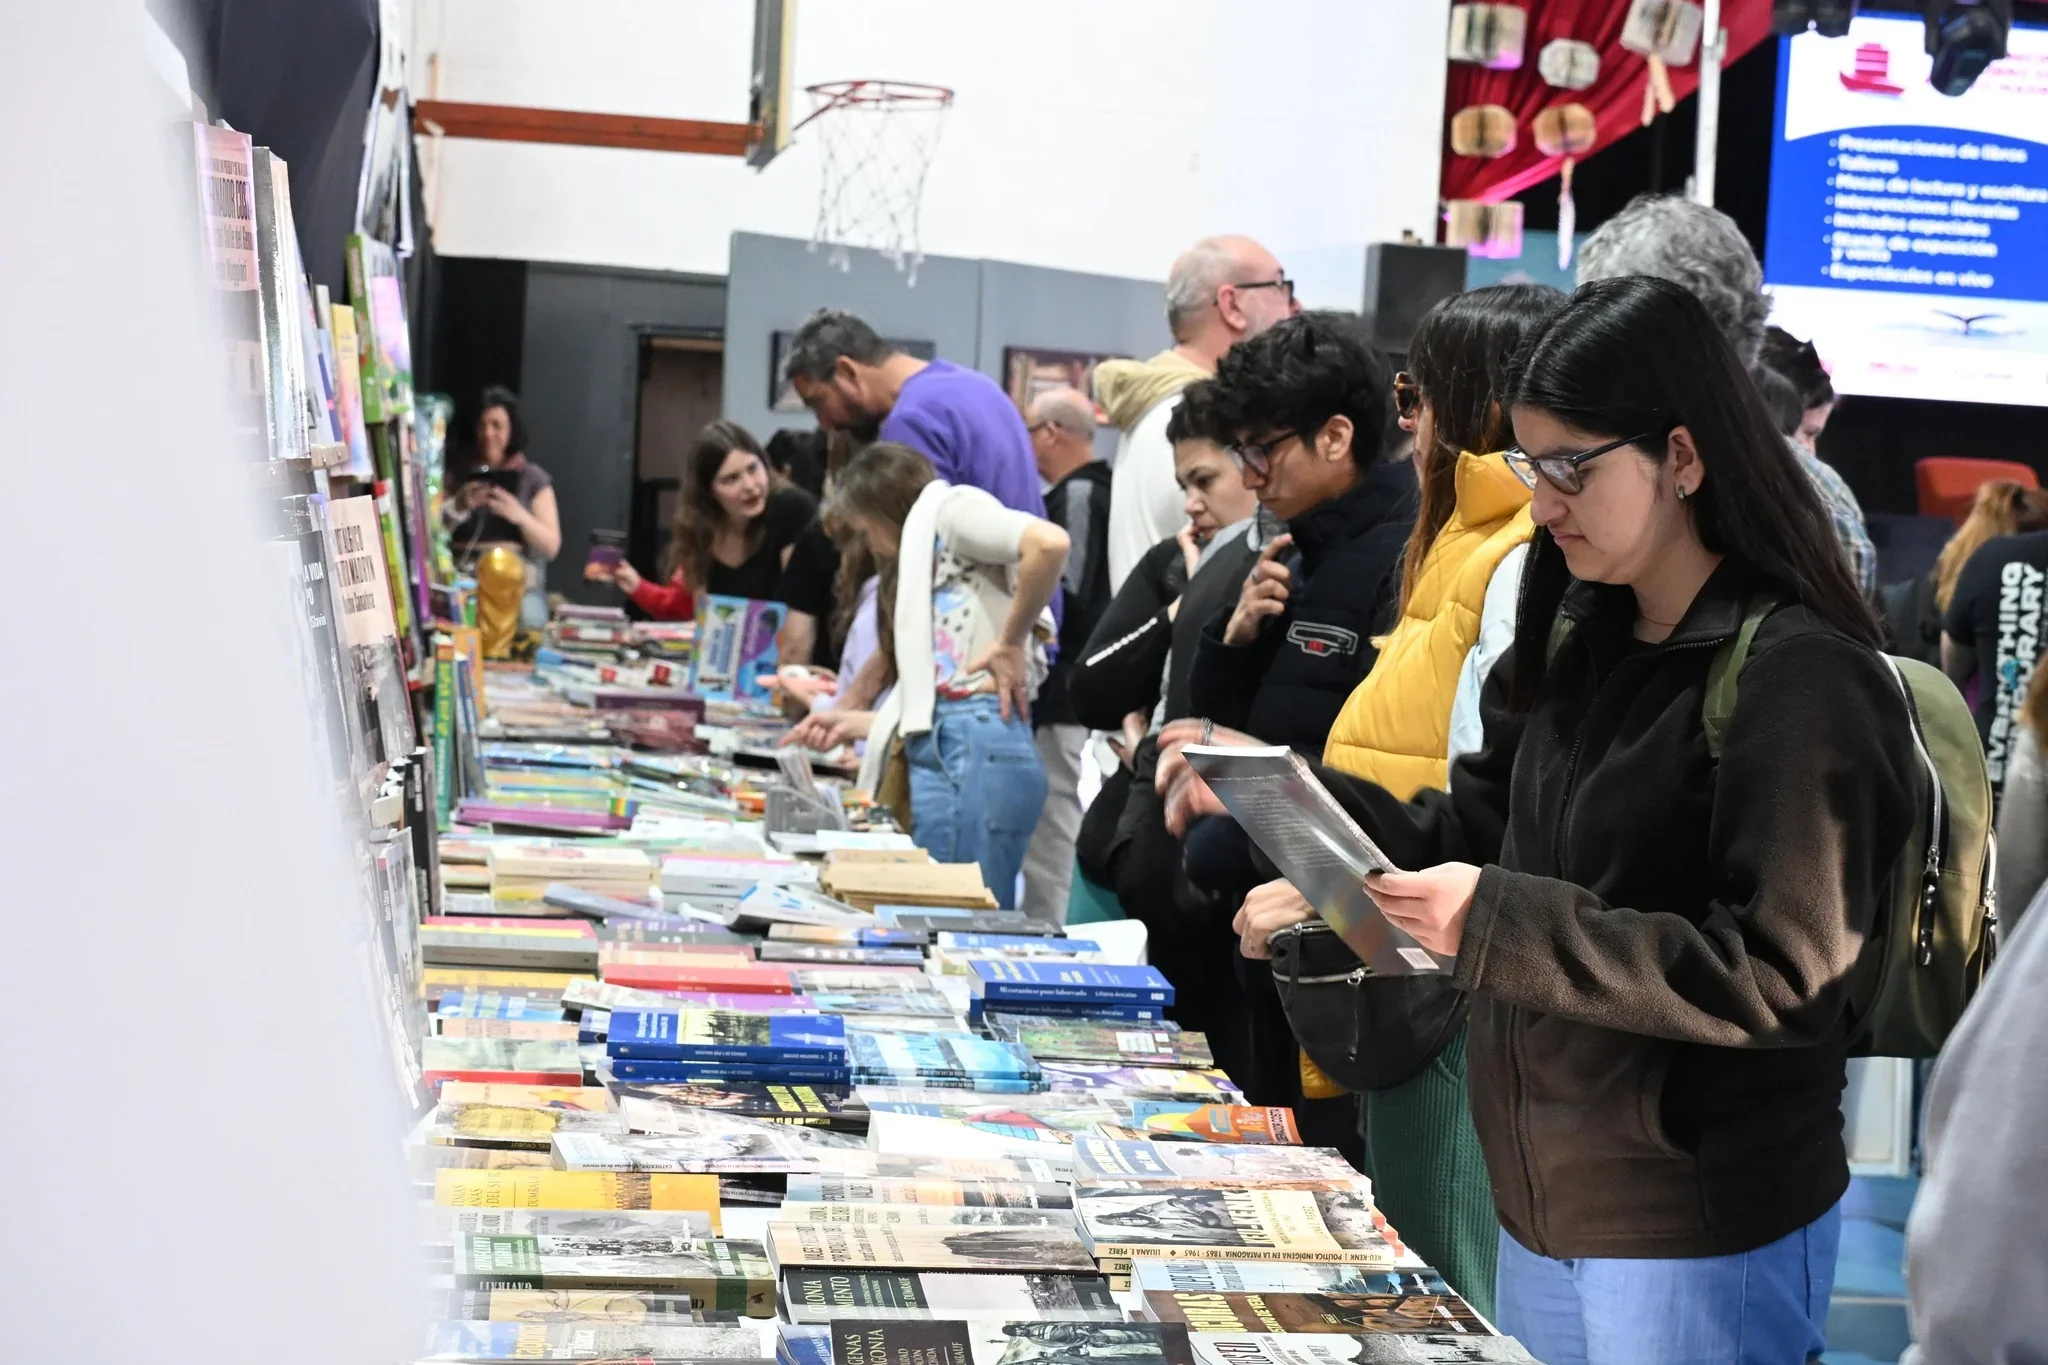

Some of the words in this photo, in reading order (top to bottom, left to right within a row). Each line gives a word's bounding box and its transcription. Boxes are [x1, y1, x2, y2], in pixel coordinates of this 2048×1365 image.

[1108, 1247, 1128, 1256] PÉREZ
[1136, 1248, 1161, 1256] LILIANA
[1184, 1249, 1200, 1258] 1965
[1205, 1250, 1222, 1258] 1865
[1225, 1250, 1262, 1259] PATAGONIA
[1272, 1252, 1281, 1260] EN
[1282, 1251, 1314, 1261] INDÍGENA
[1314, 1252, 1342, 1262] POLÍTICA
[1350, 1253, 1382, 1262] KEU-KENK
[802, 1280, 828, 1313] COLONIA
[1245, 1295, 1266, 1309] VERA
